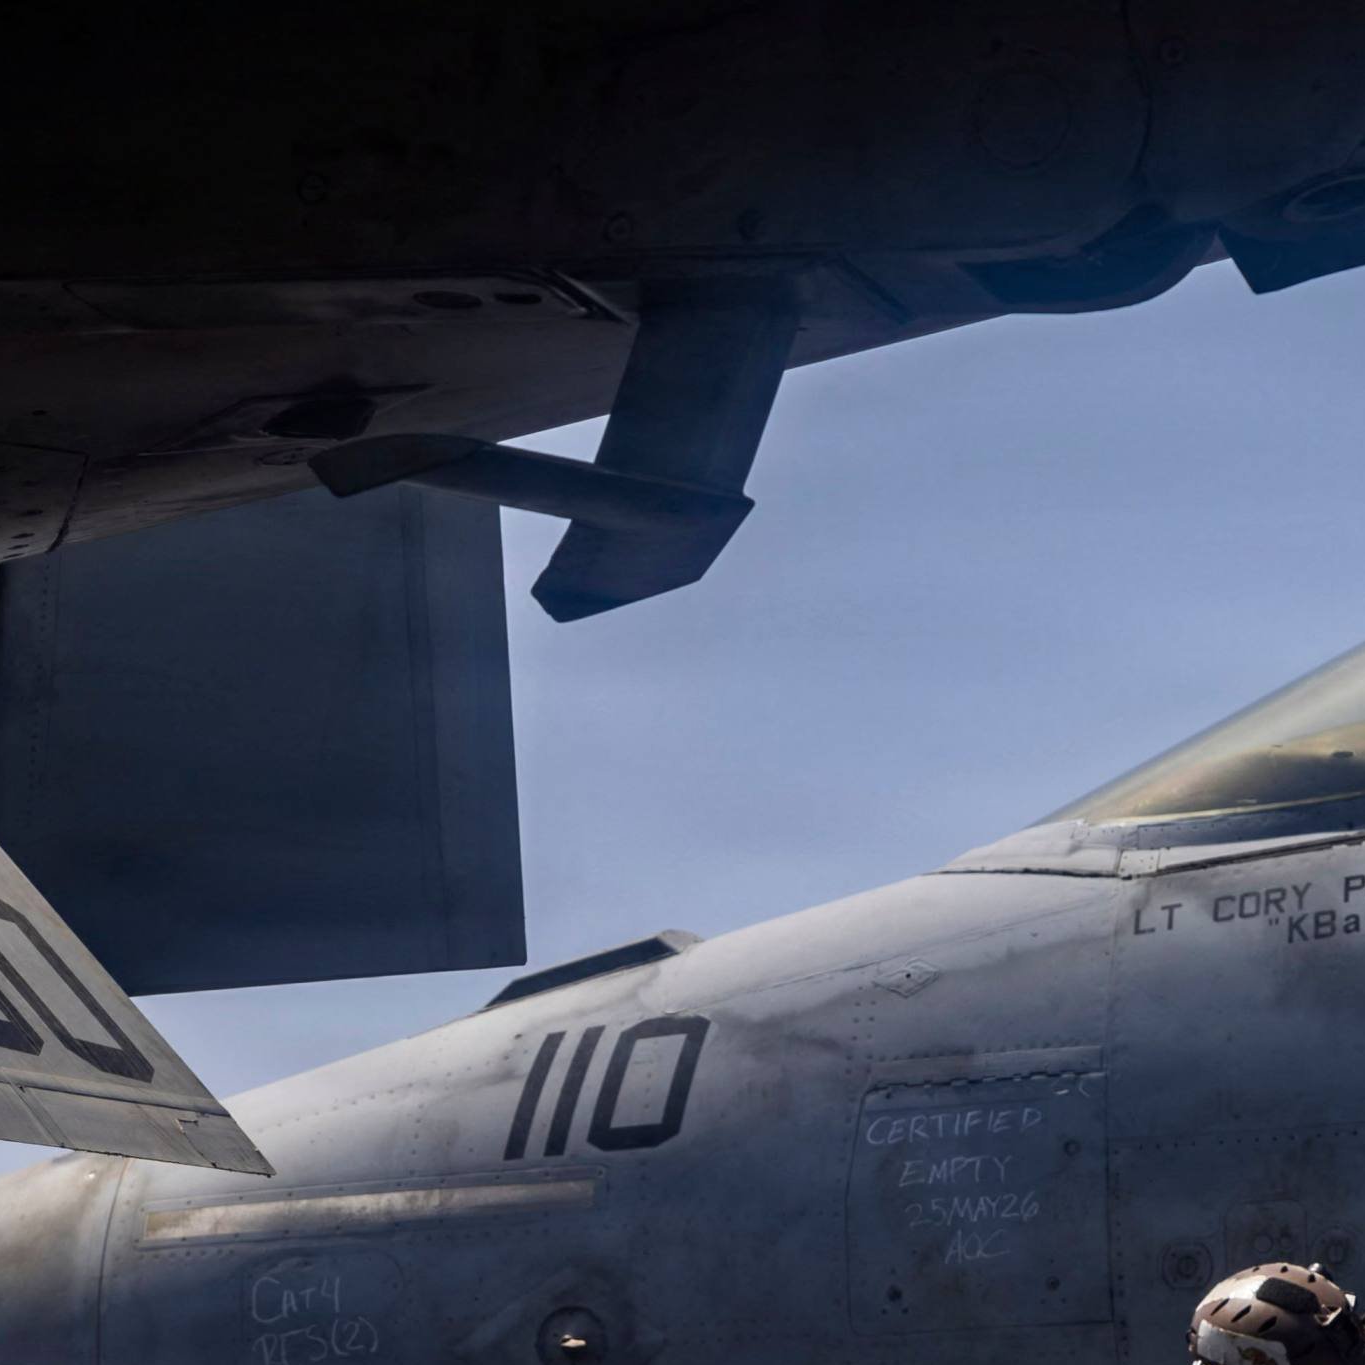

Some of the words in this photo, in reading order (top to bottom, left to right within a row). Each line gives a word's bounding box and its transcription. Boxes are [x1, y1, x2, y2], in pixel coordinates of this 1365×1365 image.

[1133, 903, 1183, 936] LT
[1212, 882, 1312, 923] CORY
[503, 1015, 711, 1161] 110
[865, 1107, 1042, 1145] CERTIFIED
[898, 1154, 1013, 1188] EMPTY
